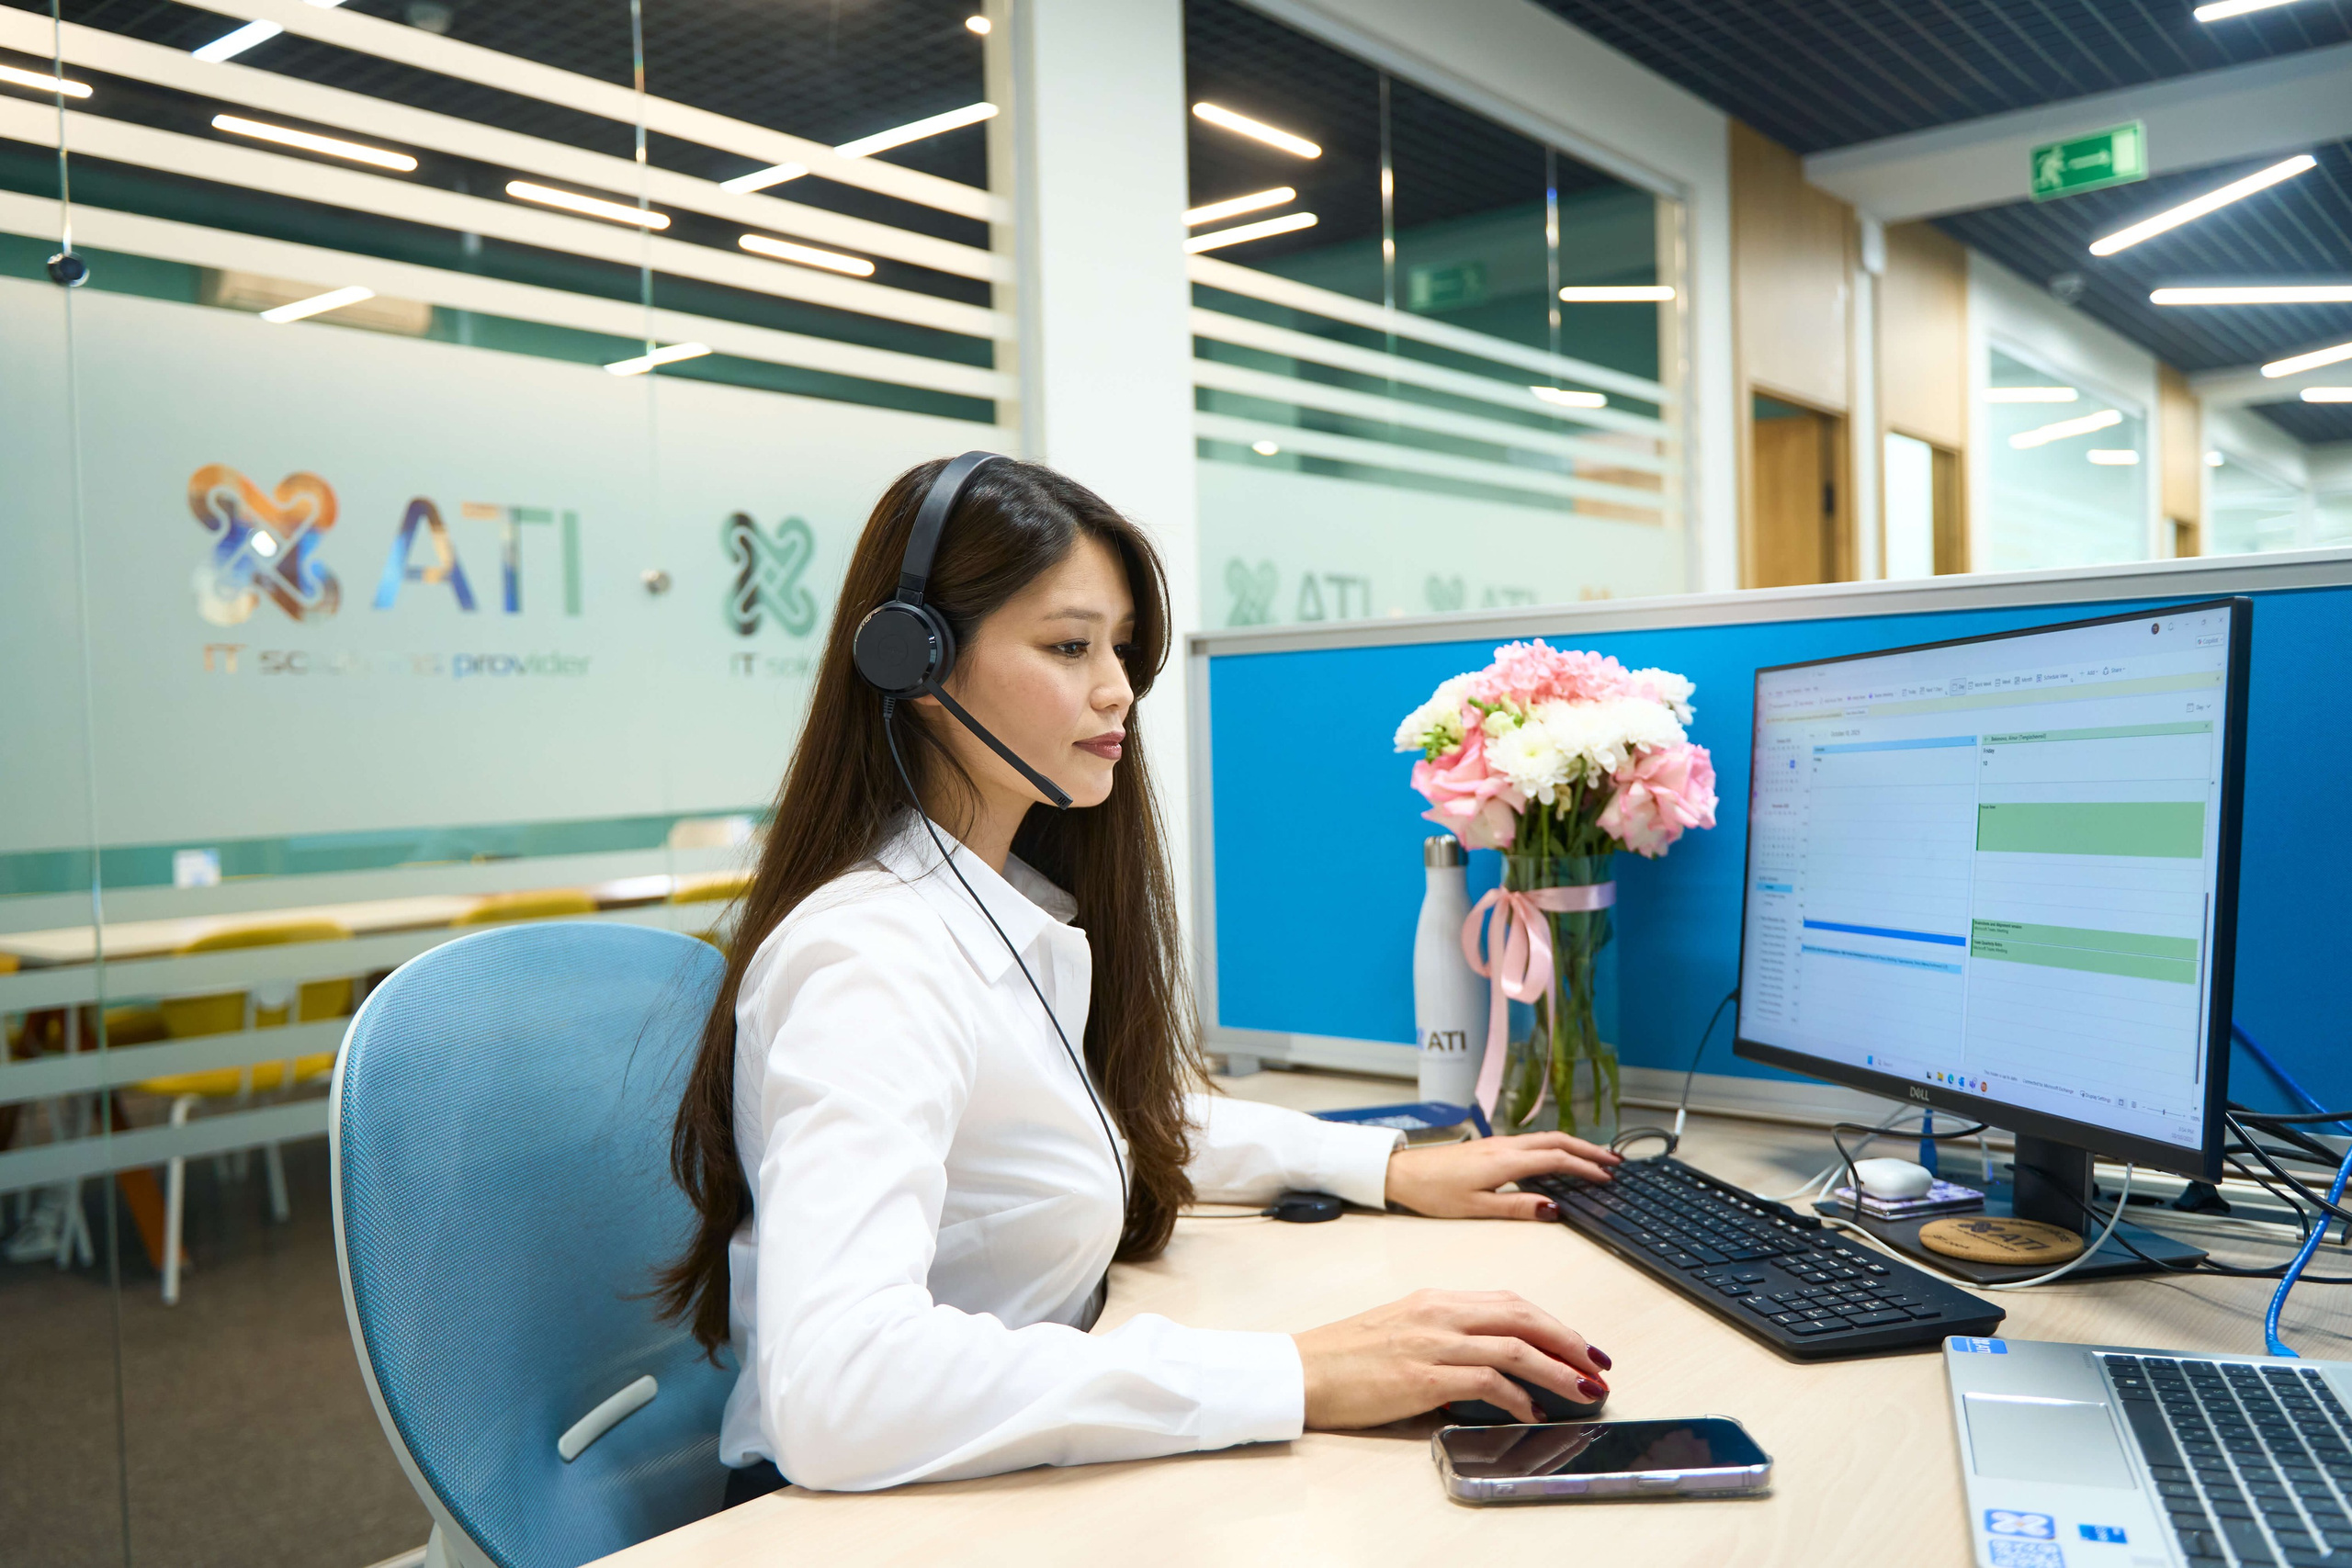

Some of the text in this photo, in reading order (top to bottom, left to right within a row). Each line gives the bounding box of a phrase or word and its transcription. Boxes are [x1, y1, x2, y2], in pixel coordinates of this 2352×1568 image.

[371, 496, 582, 616] ATI
[1296, 570, 1372, 621] ATI
[203, 643, 247, 673] IT
[451, 649, 594, 680] provider
[1427, 1030, 1466, 1051] ATI
[1910, 1086, 1929, 1101] DELL
[1987, 1232, 2052, 1251] ATI
